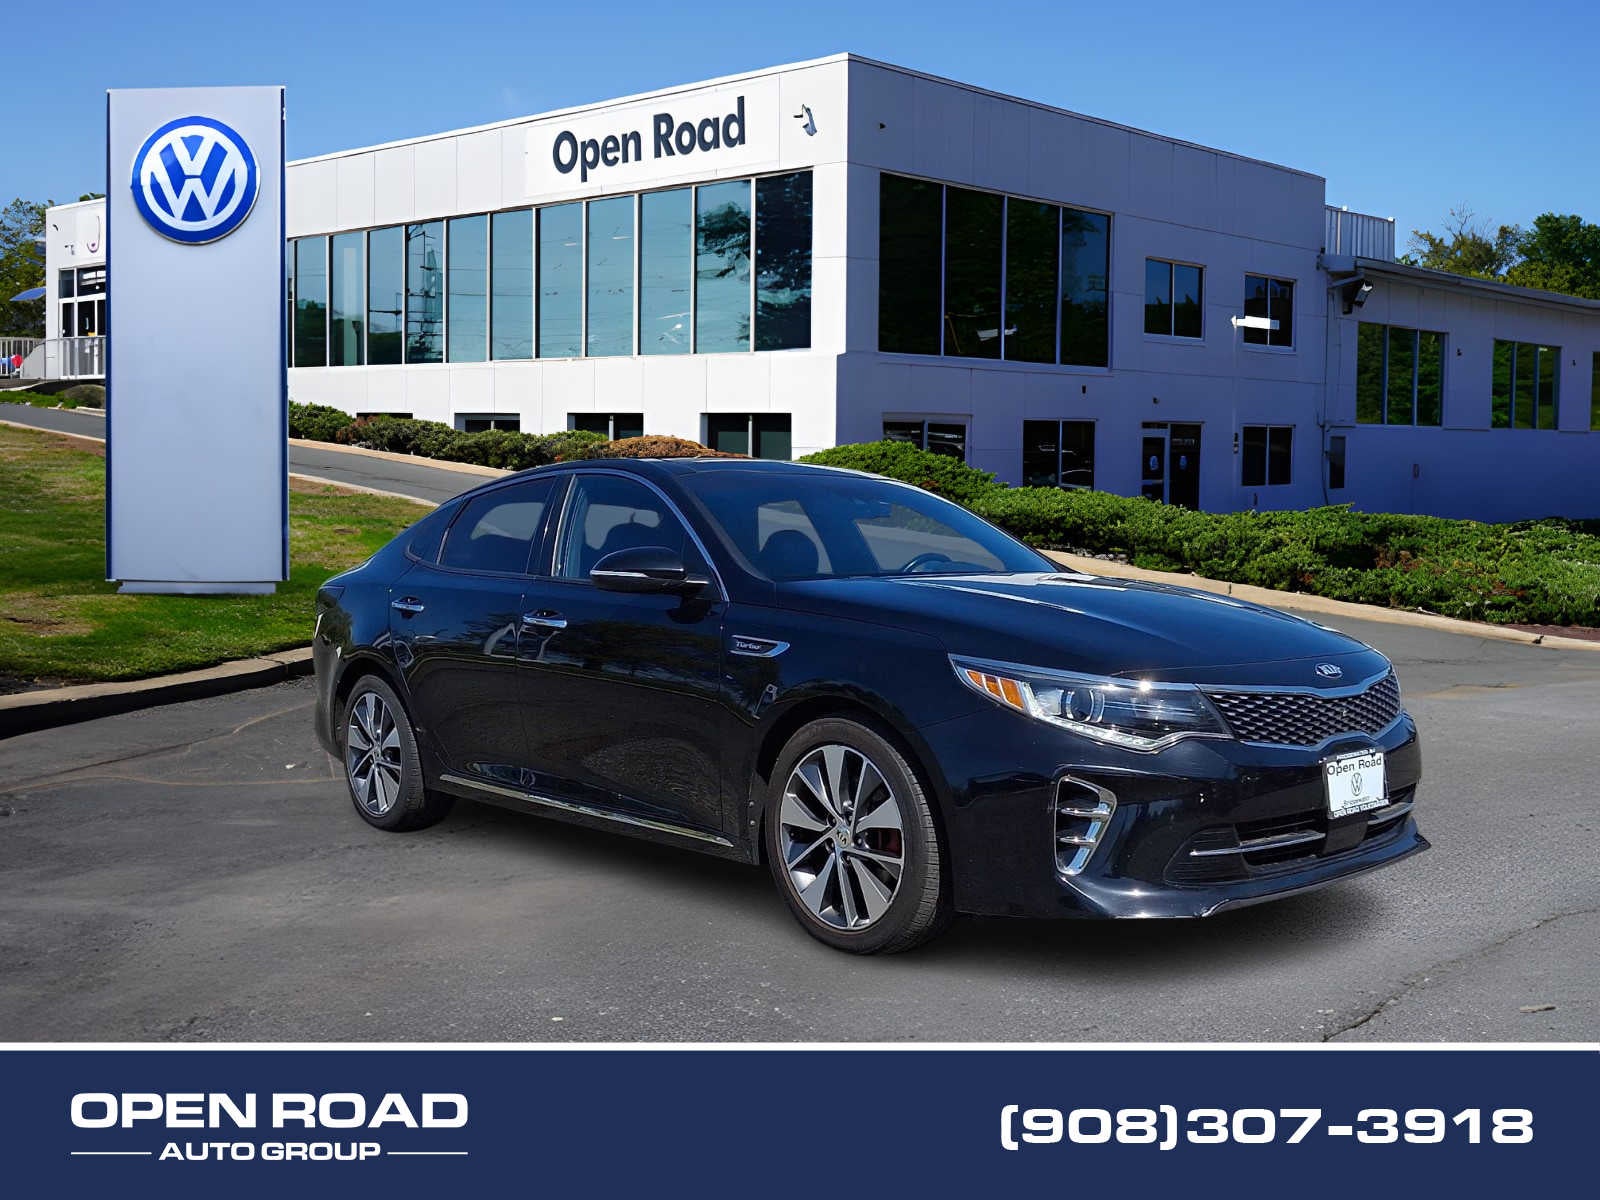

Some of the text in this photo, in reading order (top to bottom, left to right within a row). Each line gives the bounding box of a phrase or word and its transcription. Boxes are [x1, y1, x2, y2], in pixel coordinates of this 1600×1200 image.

[141, 125, 248, 231] VW
[553, 96, 746, 183] Open Road
[1326, 755, 1382, 776] Open Road
